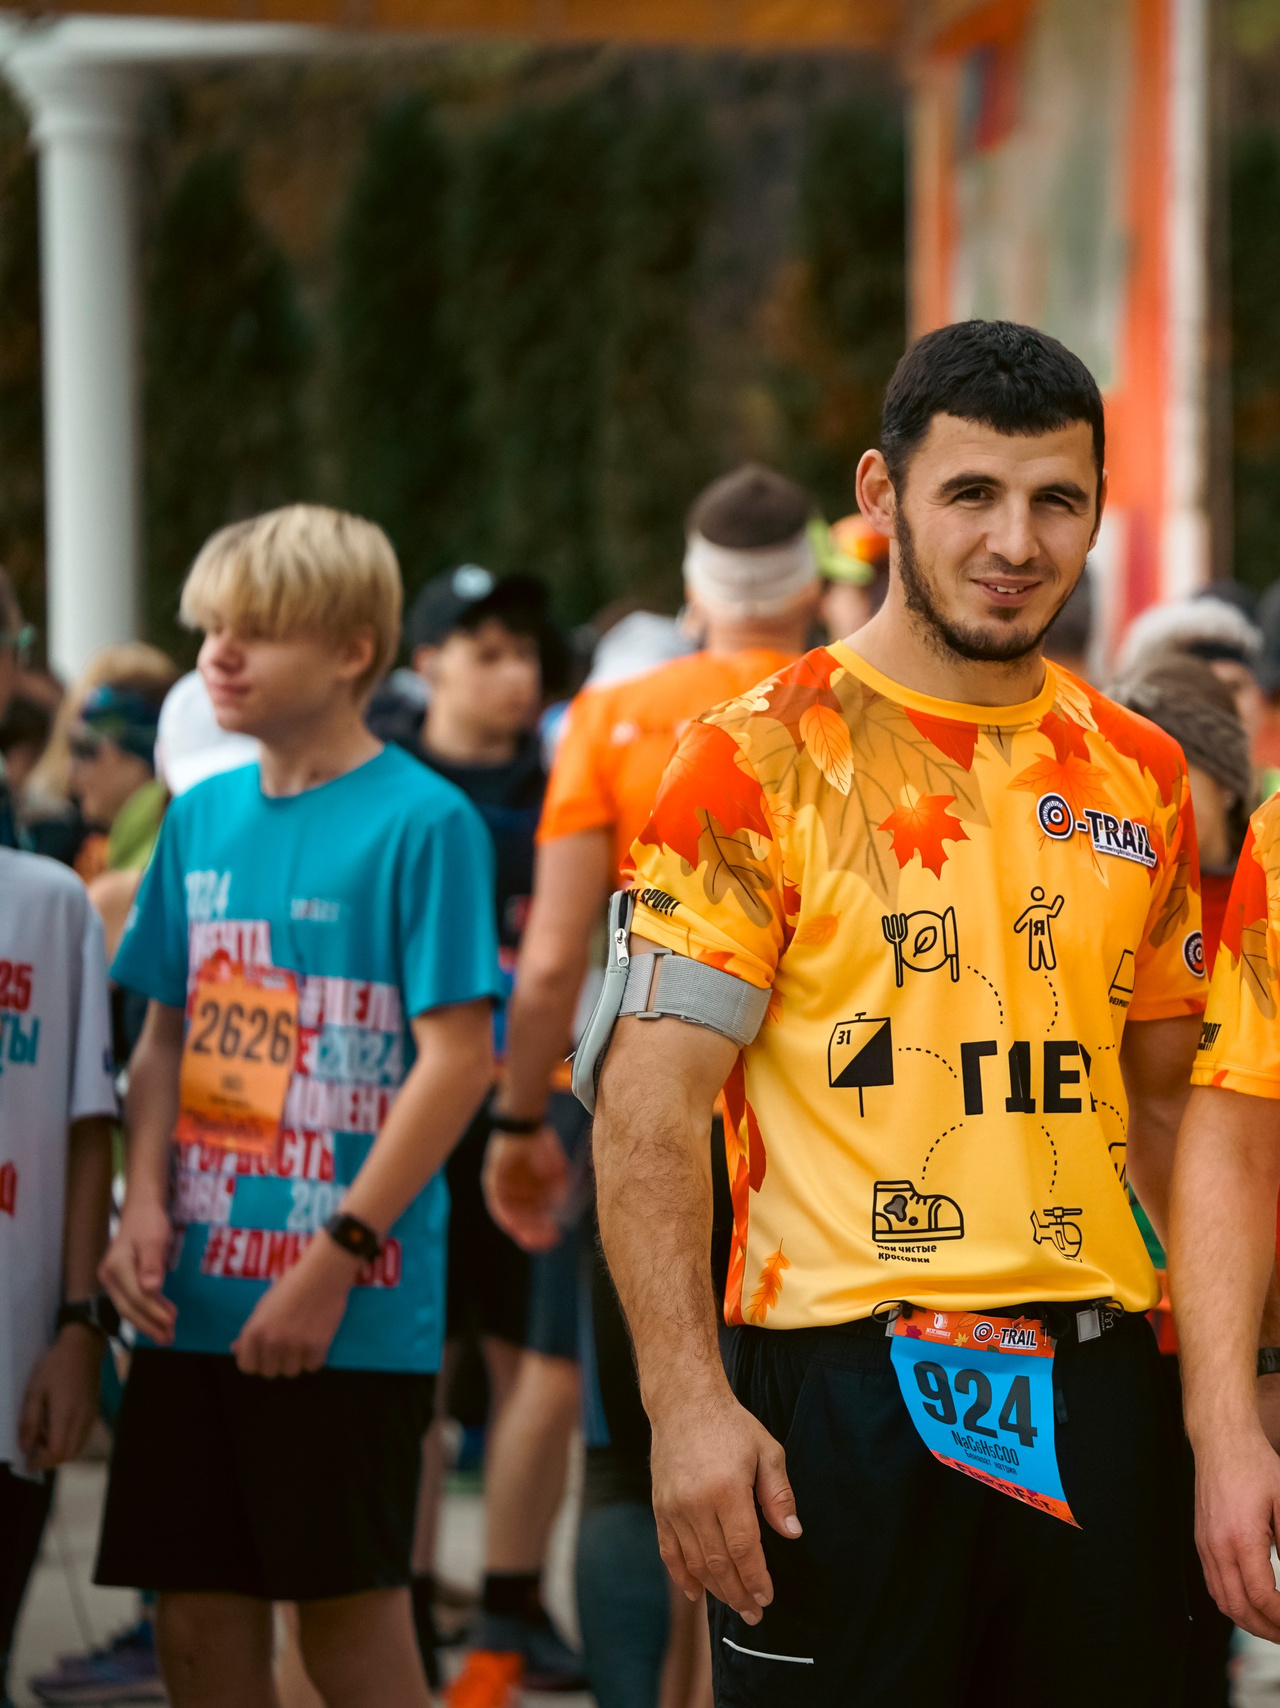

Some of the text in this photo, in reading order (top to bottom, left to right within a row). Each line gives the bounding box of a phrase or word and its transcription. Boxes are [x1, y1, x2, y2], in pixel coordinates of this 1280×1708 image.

[192, 1000, 293, 1065] 2626
[836, 1030, 851, 1045] 31
[898, 1244, 937, 1254] чистые
[878, 1252, 930, 1264] кроссовки
[913, 1361, 1038, 1449] 924
